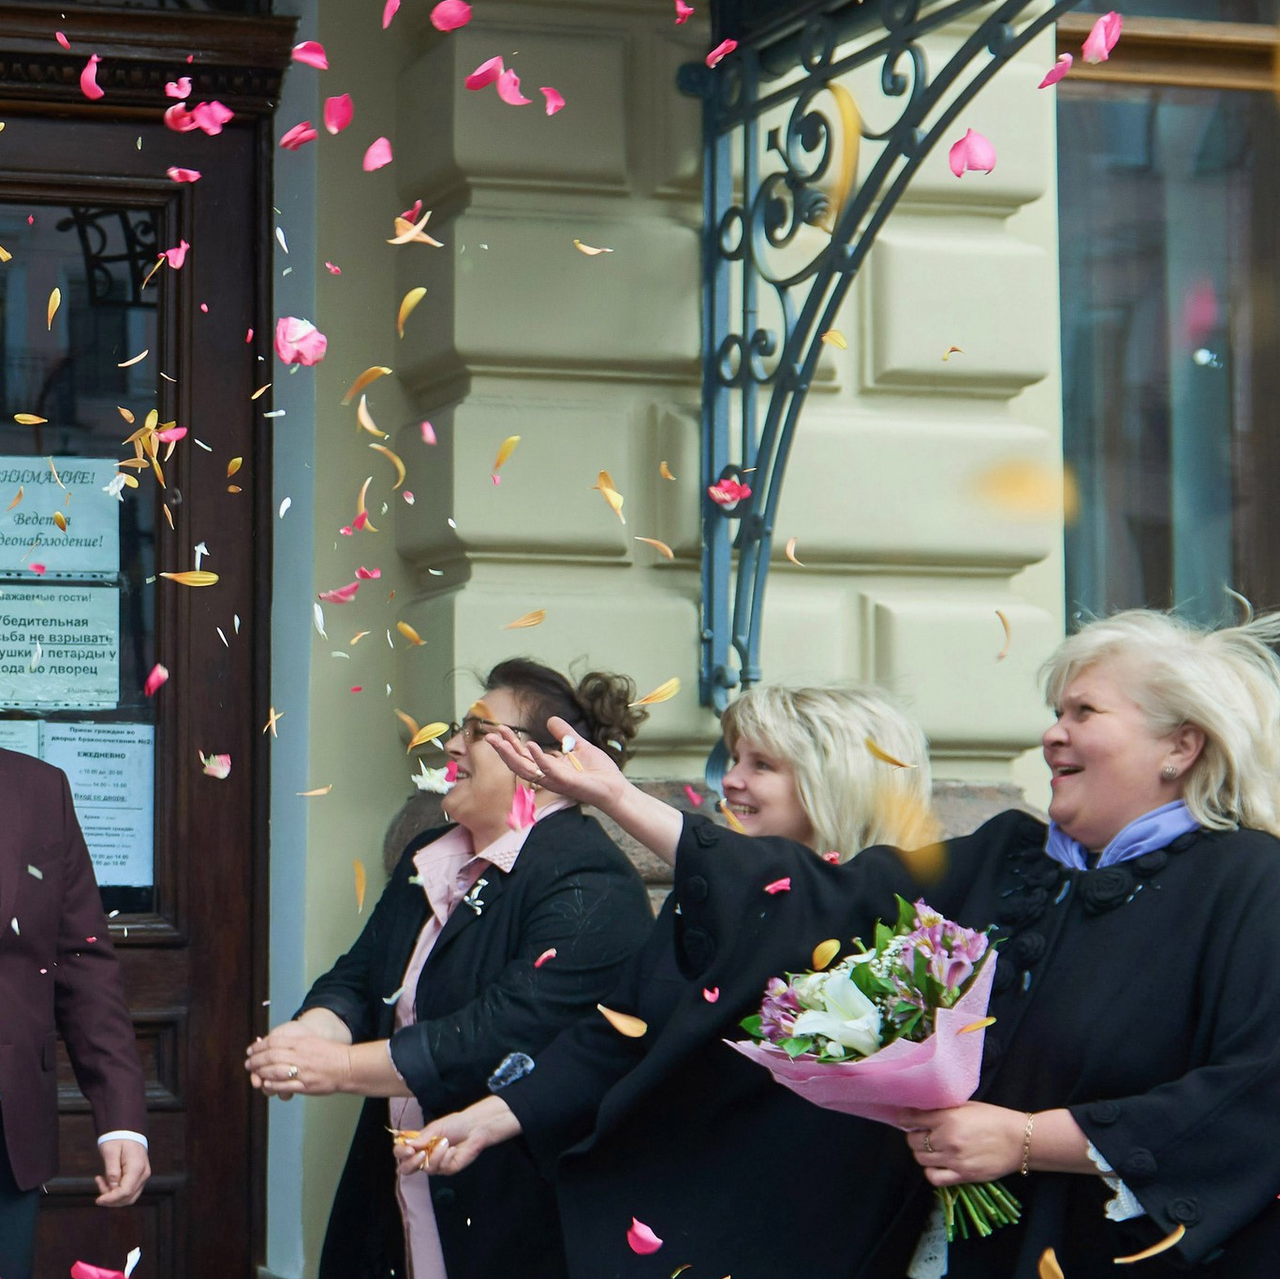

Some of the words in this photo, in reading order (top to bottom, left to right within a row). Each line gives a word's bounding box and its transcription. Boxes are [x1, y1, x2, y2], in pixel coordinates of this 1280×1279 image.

[13, 511, 71, 527] Ведетя
[58, 593, 92, 603] гости!
[29, 633, 45, 643] не
[48, 649, 106, 661] петарды
[109, 650, 117, 662] у
[48, 665, 98, 676] дворец
[77, 751, 127, 759] ЕЖЕДНЕВНО
